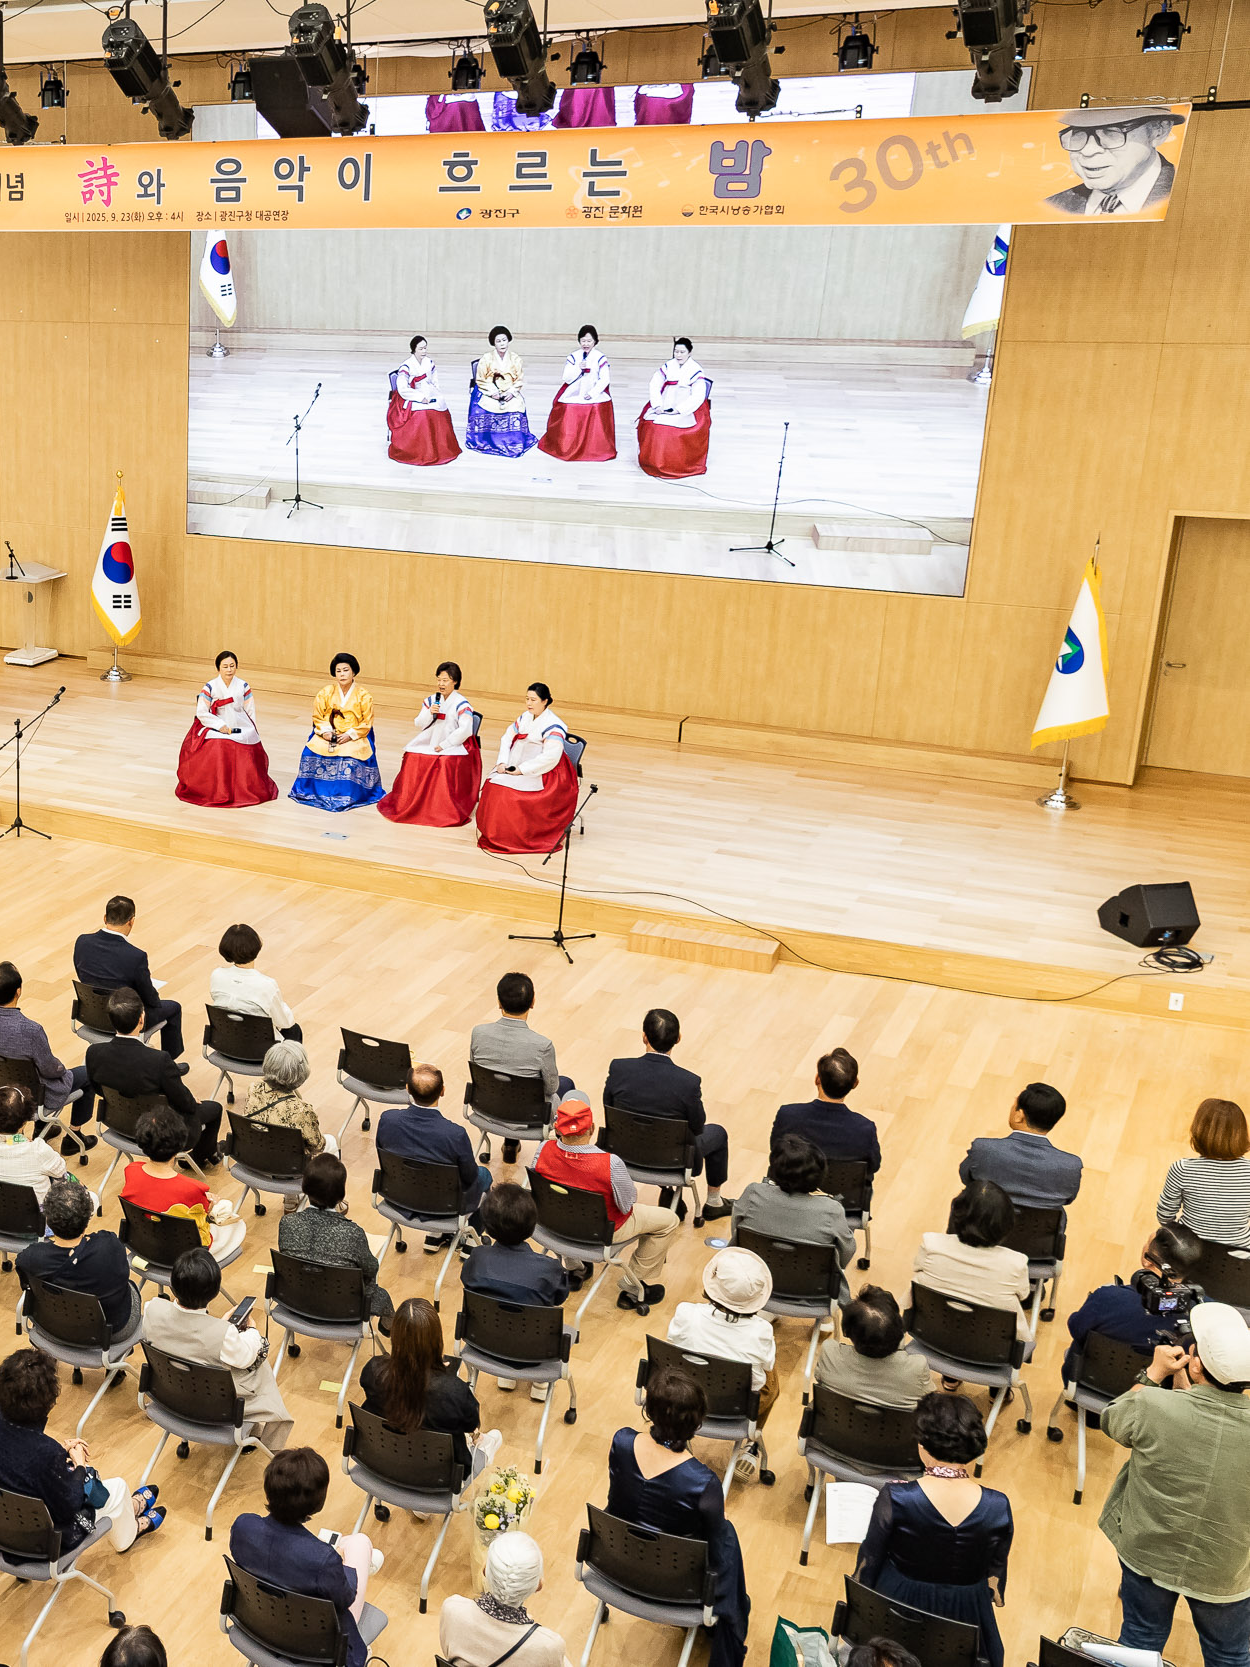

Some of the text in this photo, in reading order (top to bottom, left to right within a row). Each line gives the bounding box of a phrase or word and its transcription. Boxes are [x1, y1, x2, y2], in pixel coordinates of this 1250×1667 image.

[709, 139, 772, 199] 밤
[829, 130, 975, 214] 30th
[147, 211, 163, 222] 오후
[170, 211, 184, 222] 4시
[196, 210, 289, 222] 장소 광진구청 대공연장
[479, 208, 521, 219] 광진구
[581, 205, 643, 219] 광진 문화원
